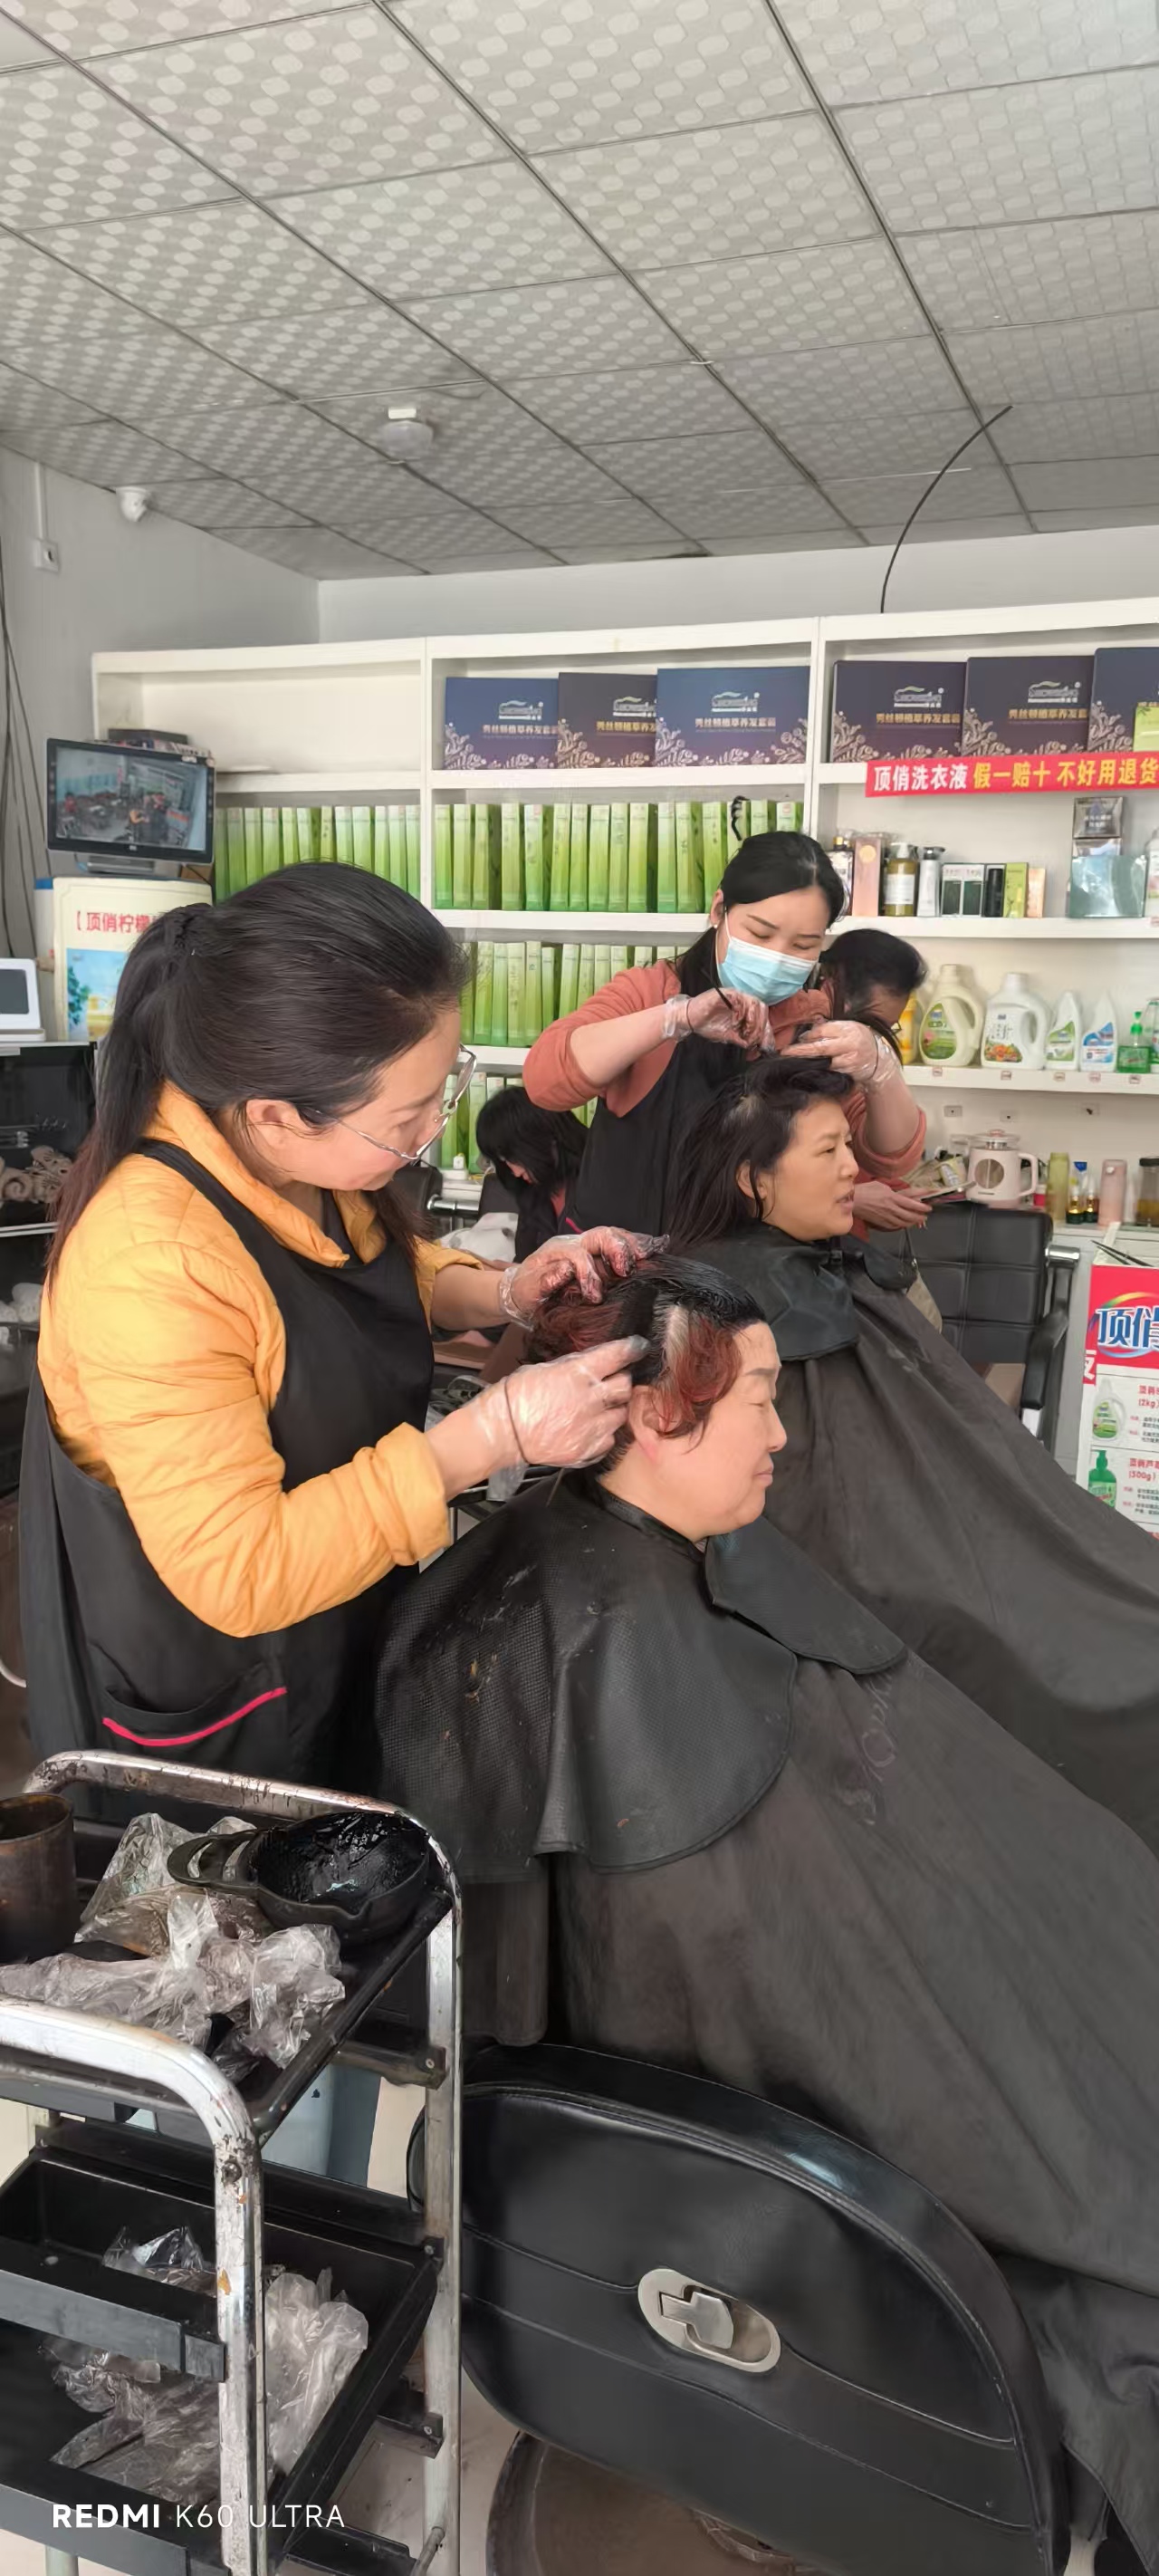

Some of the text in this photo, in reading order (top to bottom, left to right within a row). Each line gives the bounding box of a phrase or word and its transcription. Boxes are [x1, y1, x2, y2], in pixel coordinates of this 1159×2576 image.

[874, 757, 1159, 791] 顶俏洗衣液 假一赔十 不好用退货
